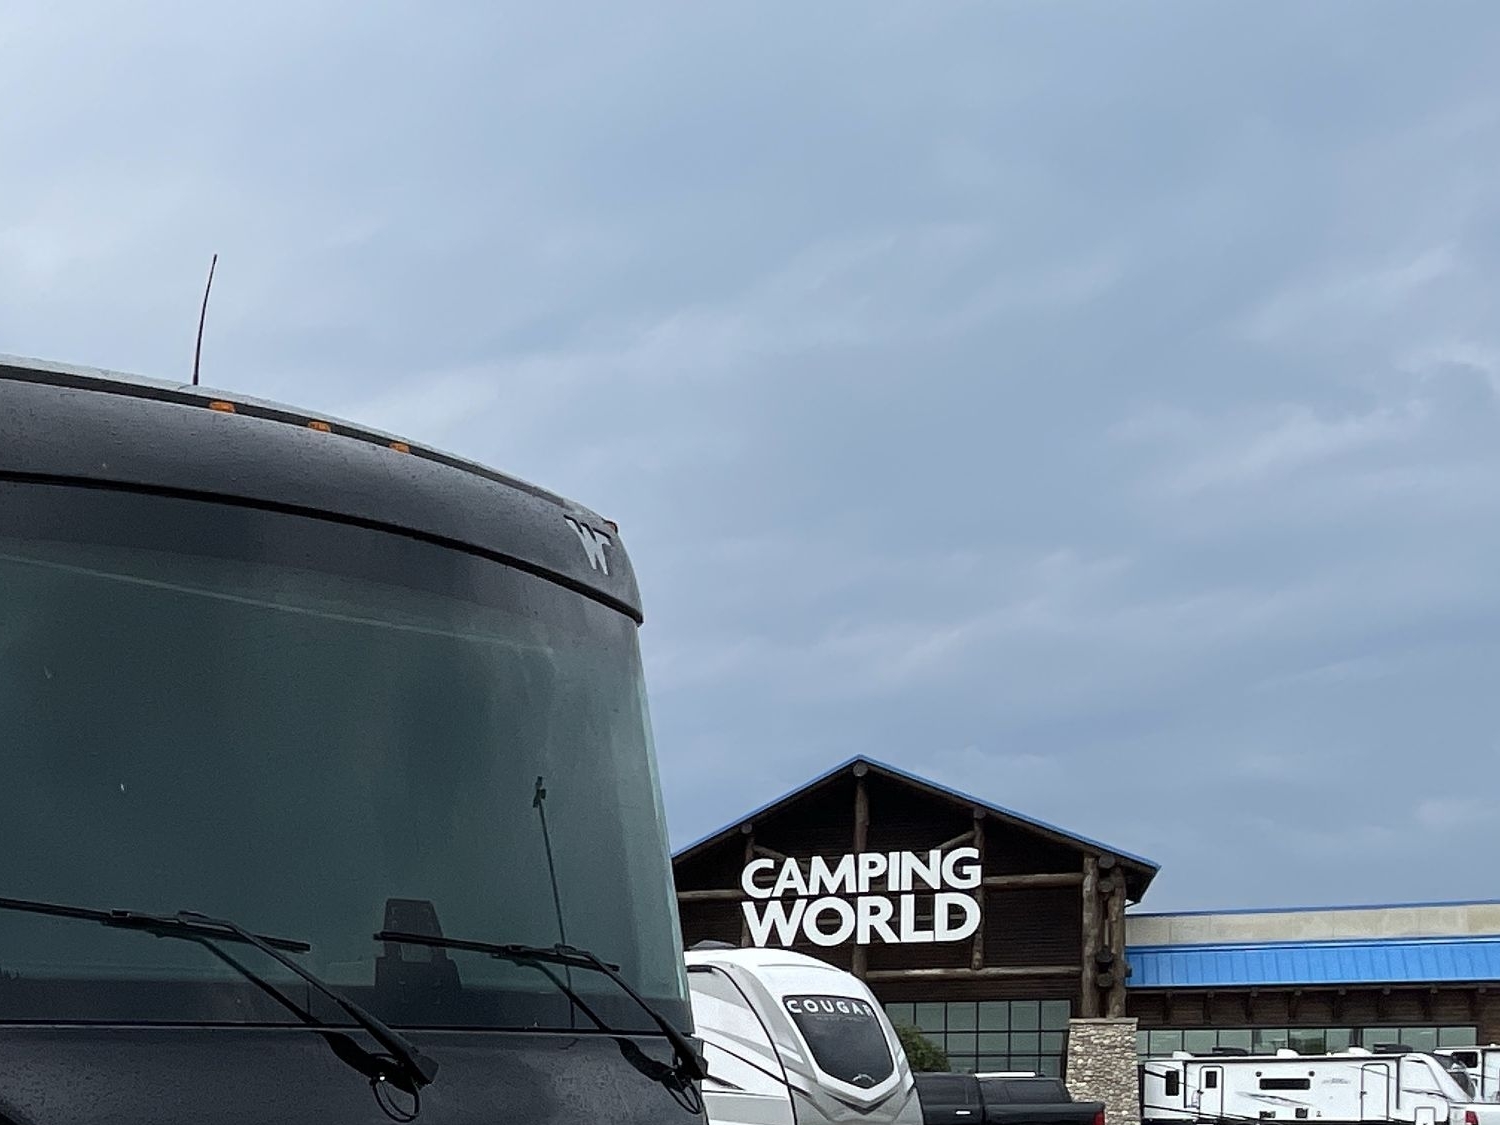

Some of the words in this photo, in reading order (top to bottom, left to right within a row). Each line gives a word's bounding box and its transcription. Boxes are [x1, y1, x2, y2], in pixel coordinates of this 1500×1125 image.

[741, 847, 982, 899] CAMPING
[741, 892, 981, 947] WORLD
[787, 999, 875, 1018] COUGAR
